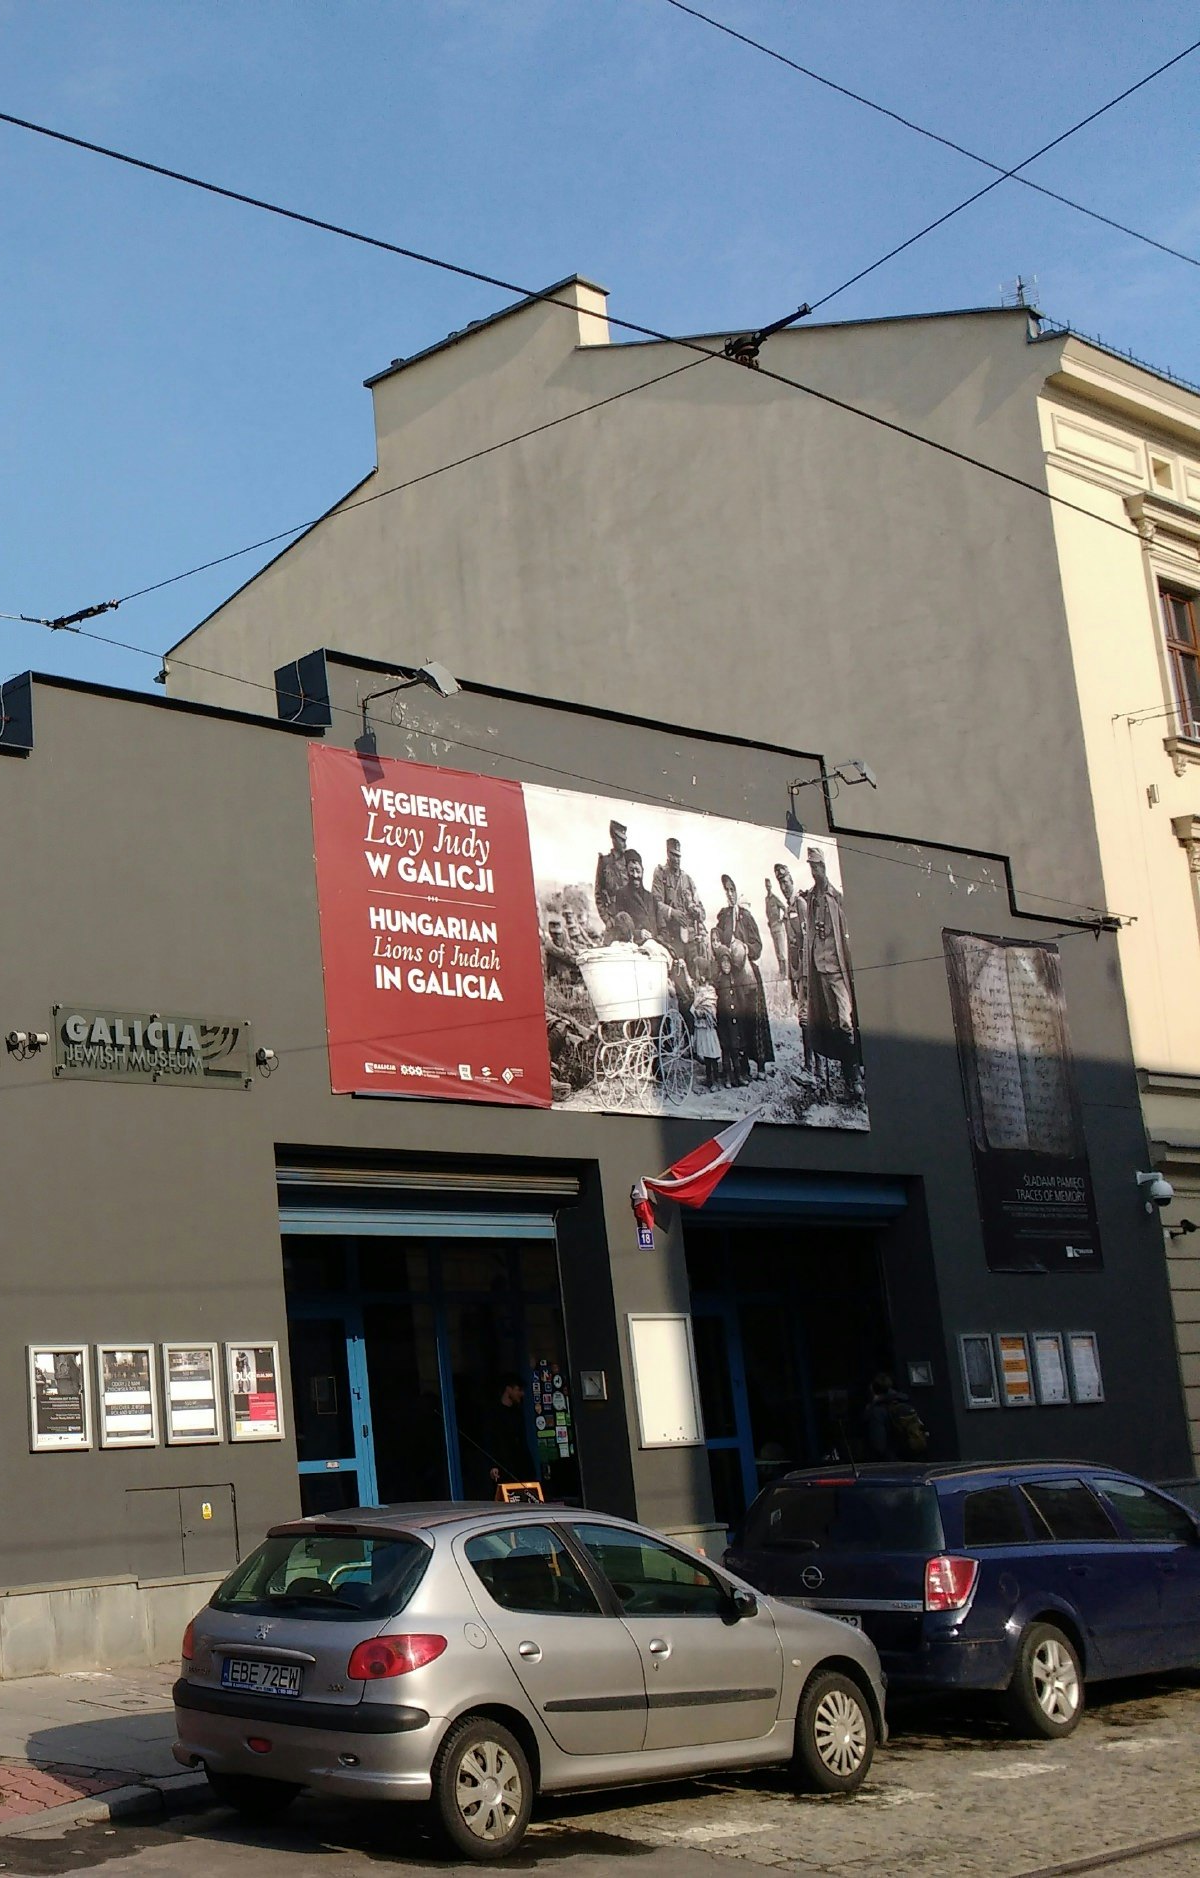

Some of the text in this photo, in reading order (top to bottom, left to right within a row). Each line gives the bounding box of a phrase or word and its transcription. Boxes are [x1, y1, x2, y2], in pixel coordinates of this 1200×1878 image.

[360, 785, 489, 828] WĘGIERSKIE
[363, 811, 491, 866] Lwy Judy
[364, 851, 495, 894] W GALICJI
[369, 906, 498, 944] HUNGARIAN
[373, 935, 501, 970] Lions of Judah
[375, 964, 504, 1002] IN GALICIA
[65, 1014, 201, 1051] GALICIA
[66, 1044, 204, 1071] JEWISH MUSEUM
[1016, 1189, 1043, 1202] TRACES
[641, 1233, 651, 1244] 18
[230, 1661, 259, 1684] EBE
[262, 1665, 299, 1689] 72EW
